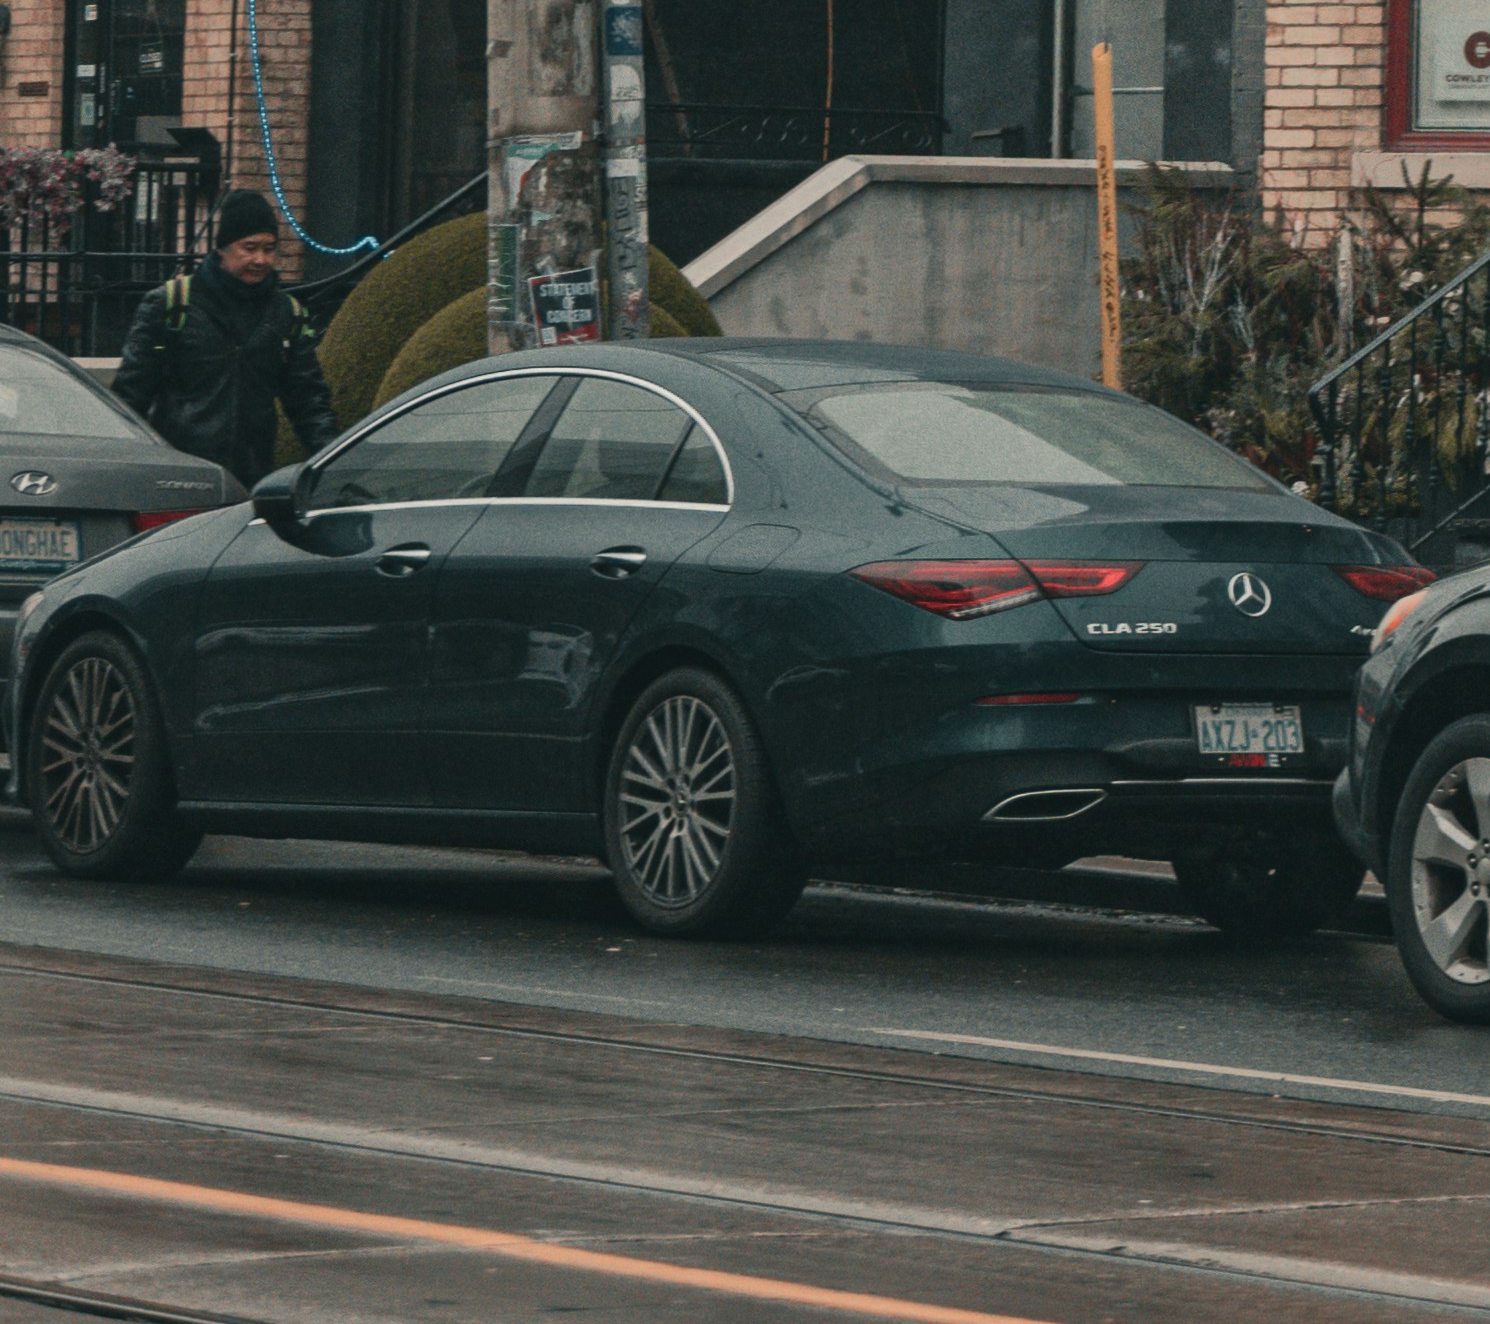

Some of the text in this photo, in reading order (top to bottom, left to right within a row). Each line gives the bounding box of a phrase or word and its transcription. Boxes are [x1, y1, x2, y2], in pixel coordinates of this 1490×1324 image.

[1446, 74, 1490, 83] COWLEY
[1087, 622, 1177, 635] CLA 250
